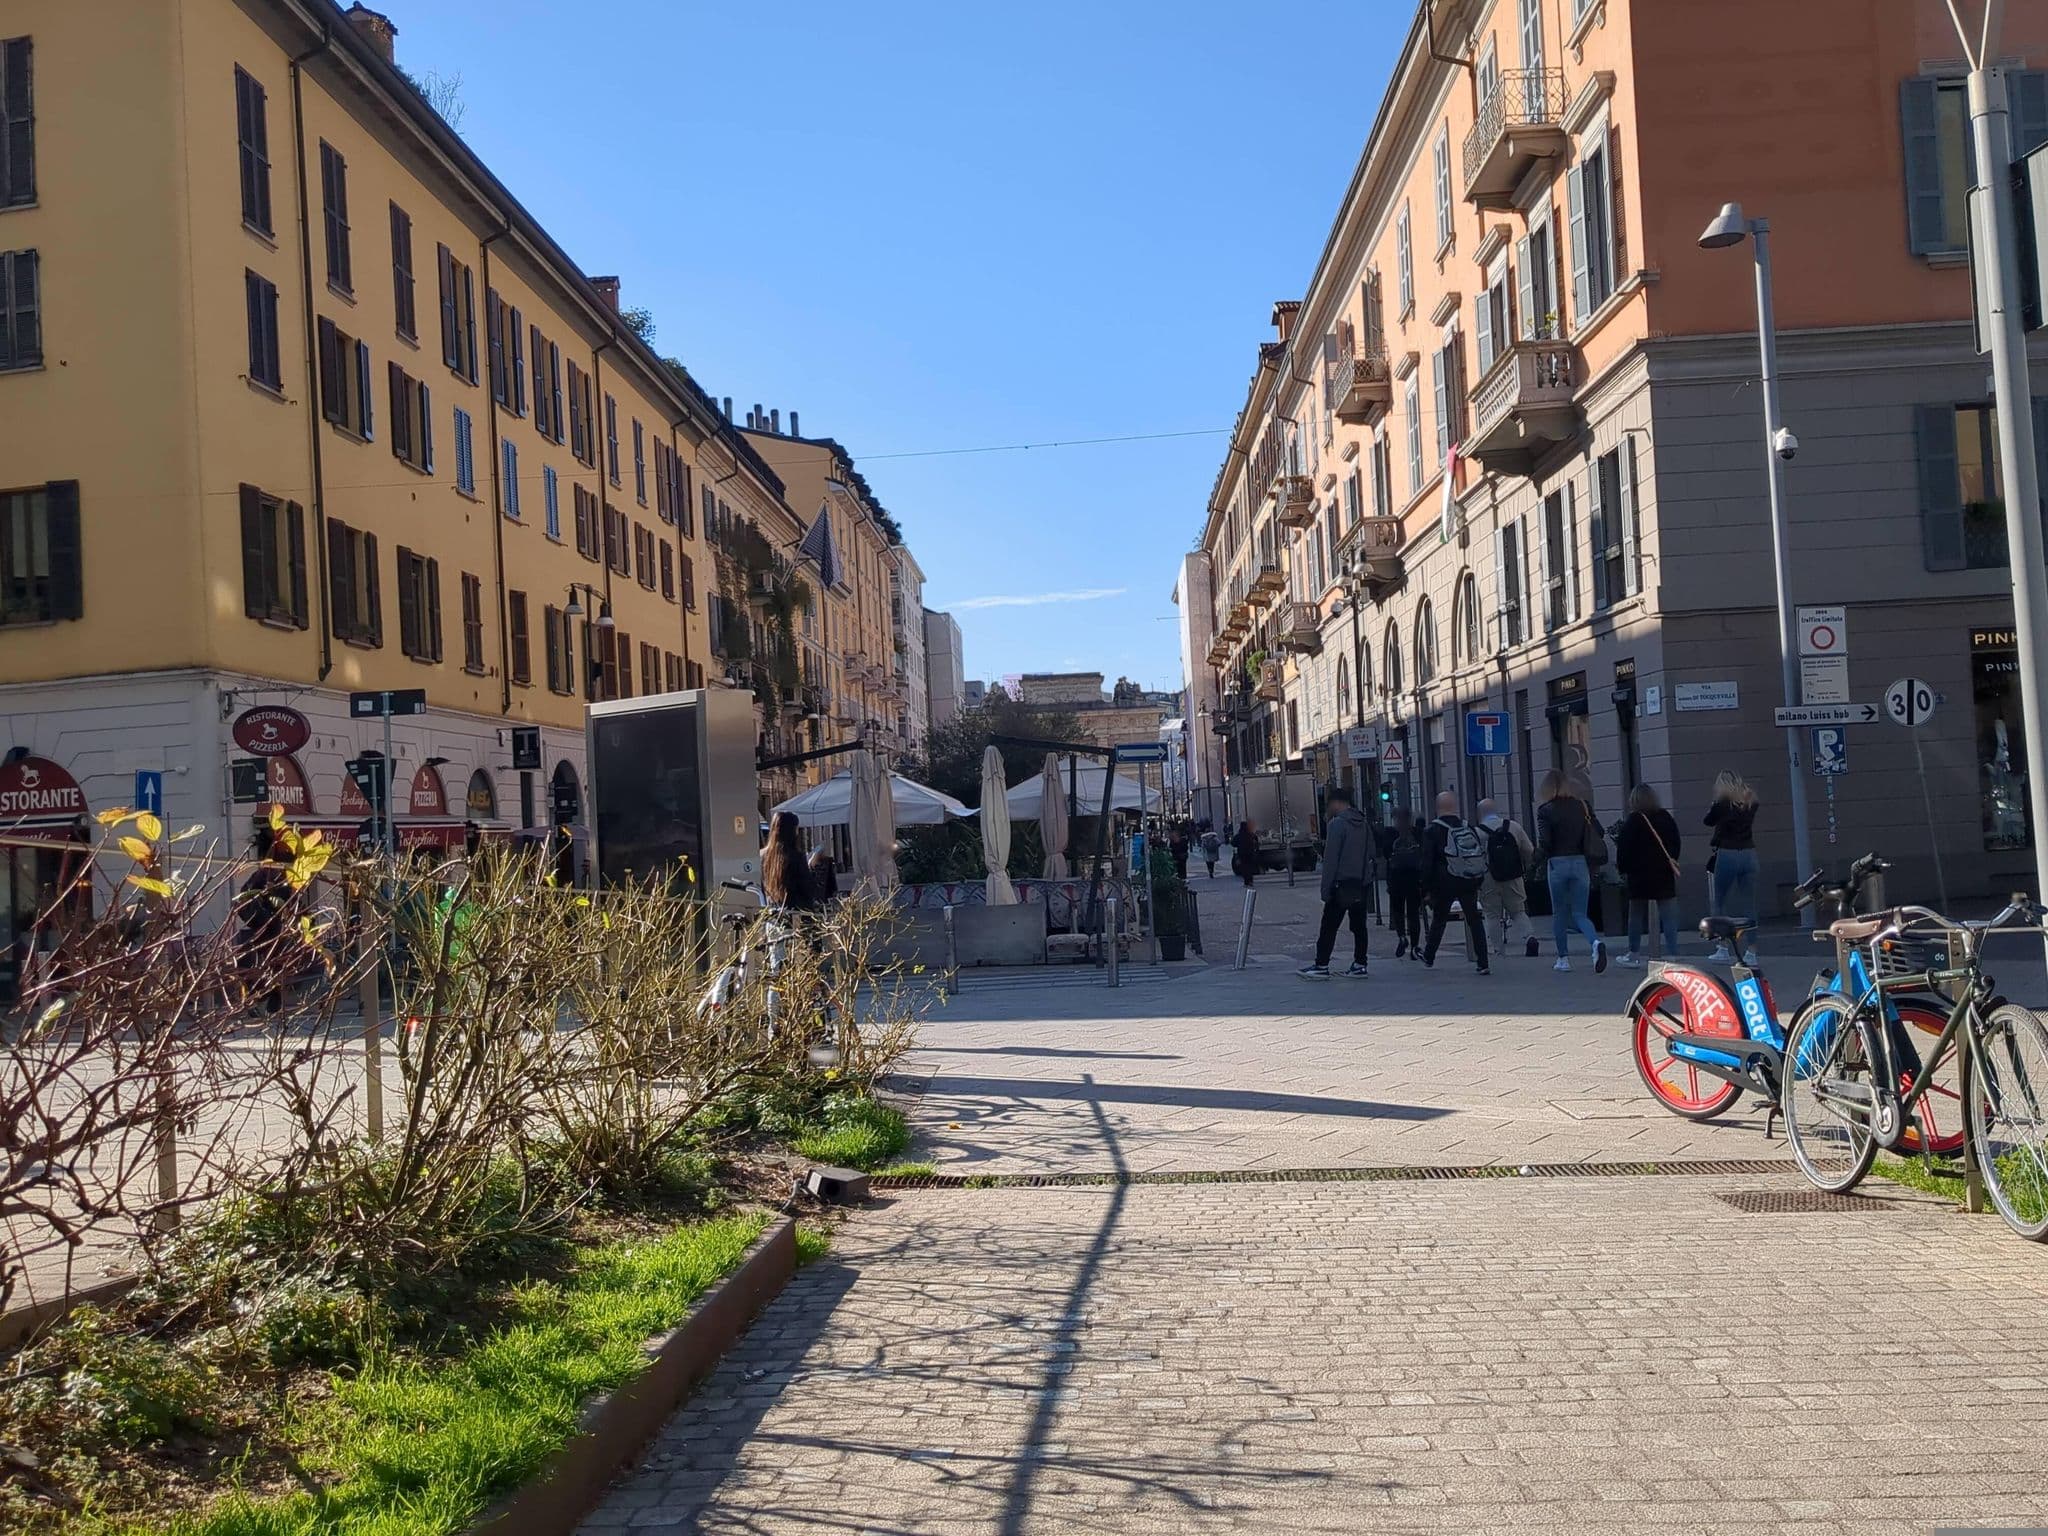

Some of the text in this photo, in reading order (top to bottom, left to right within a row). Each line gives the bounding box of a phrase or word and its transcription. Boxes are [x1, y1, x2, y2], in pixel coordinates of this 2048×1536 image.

[246, 711, 297, 726] RISTORANTE
[1777, 708, 1850, 721] milano luiss hub
[248, 739, 289, 752] PIZZERIA
[0, 788, 80, 811] STORANTE
[1672, 972, 1725, 1027] TRY FREE
[1740, 984, 1768, 1037] dott
